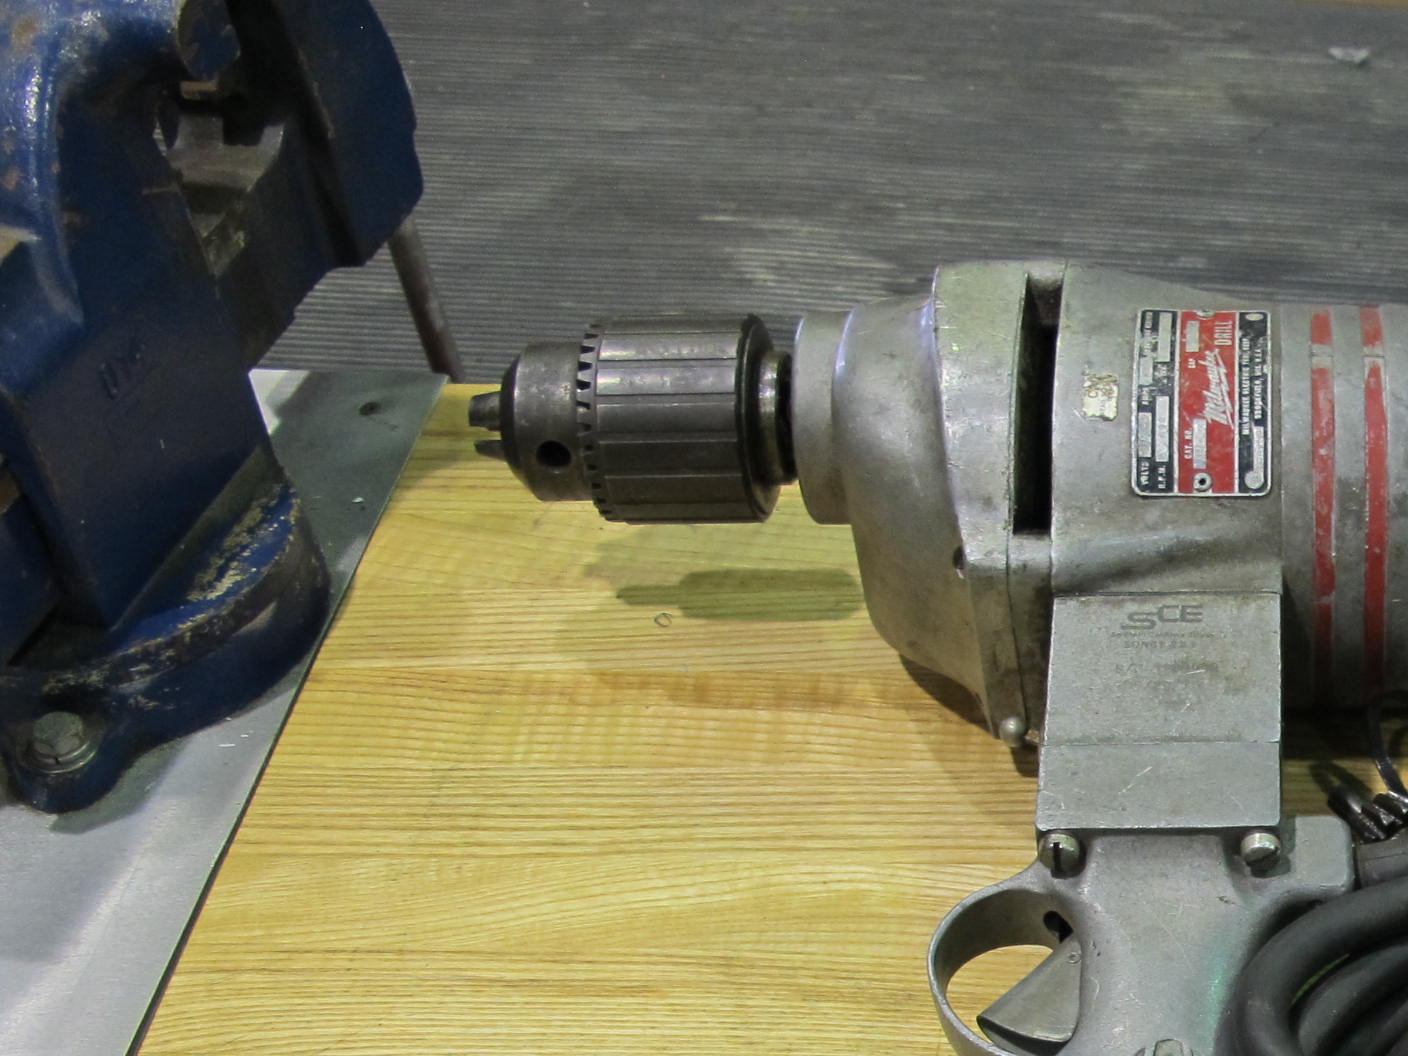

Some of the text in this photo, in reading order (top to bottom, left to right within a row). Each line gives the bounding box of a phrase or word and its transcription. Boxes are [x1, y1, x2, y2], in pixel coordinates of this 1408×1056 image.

[1214, 320, 1233, 346] DRILL
[1198, 349, 1231, 426] Milwaukee
[1121, 605, 1203, 630] SCE
